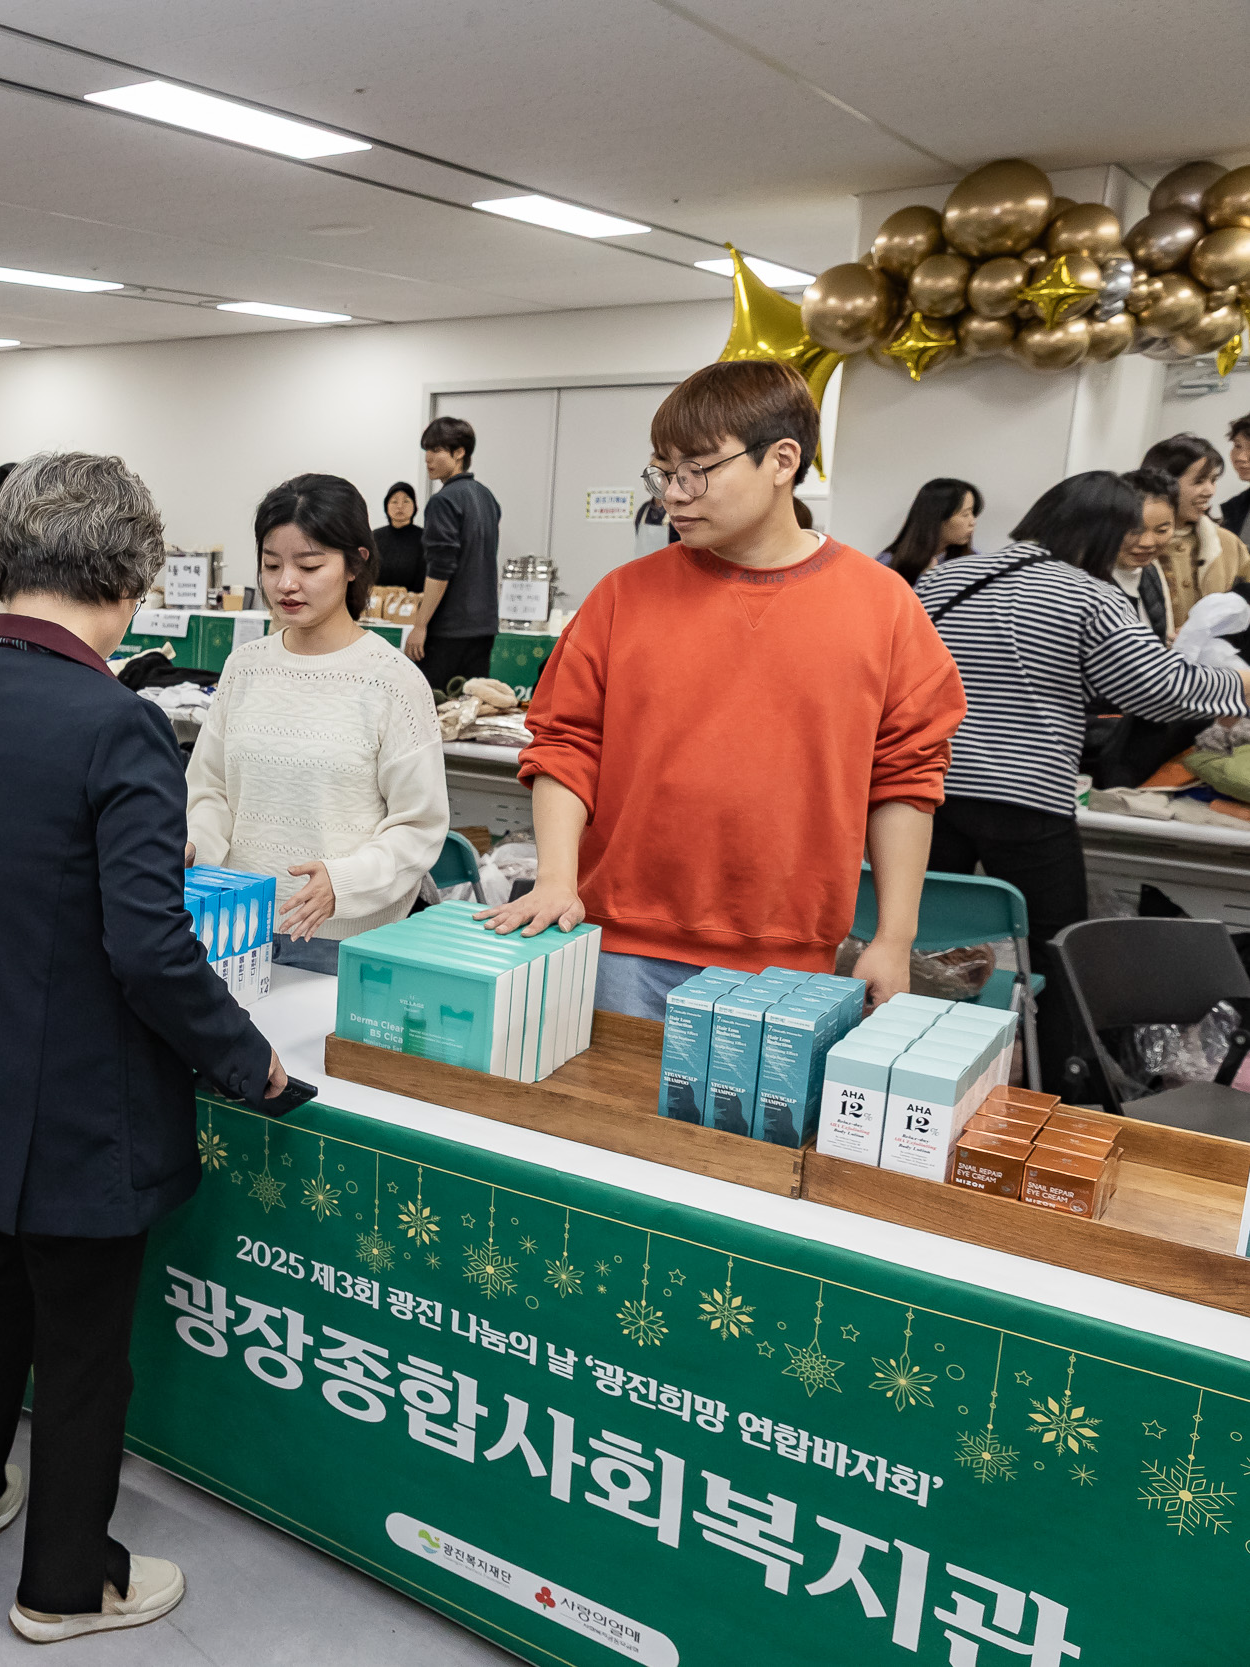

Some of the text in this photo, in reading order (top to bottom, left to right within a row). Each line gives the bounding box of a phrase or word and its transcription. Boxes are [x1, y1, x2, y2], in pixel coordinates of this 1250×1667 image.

[350, 1012, 405, 1033] Derma Clear
[370, 1028, 381, 1038] B5
[384, 1031, 404, 1044] Cica
[664, 1071, 698, 1083] VEGAN SCALP
[664, 1076, 689, 1086] SHAMPOO
[710, 1087, 737, 1097] SHAMPOO
[711, 1082, 730, 1090] VEGAN
[760, 1097, 787, 1107] SHAMPOO
[761, 1092, 797, 1105] VEGAN SCALP
[841, 1089, 865, 1101] AHA
[906, 1104, 932, 1116] AHA
[957, 1169, 997, 1184] EYE CREAM
[958, 1162, 1003, 1179] SNAIL REPAIR
[955, 1178, 985, 1190] MIZON
[1027, 1181, 1075, 1198] SNAIL REPAIR
[1025, 1197, 1056, 1209] MIZON
[1026, 1188, 1068, 1204] EYE CREAM
[236, 1235, 305, 1280] 2025
[311, 1259, 379, 1310] 제3회
[386, 1286, 442, 1332] 광진
[451, 1308, 537, 1365] 나눔의
[547, 1342, 578, 1381] 날
[165, 1266, 1081, 1667] 광장종합사회복지관
[444, 1542, 511, 1584] 광진복지재단
[561, 1598, 641, 1643] 사랑의열매
